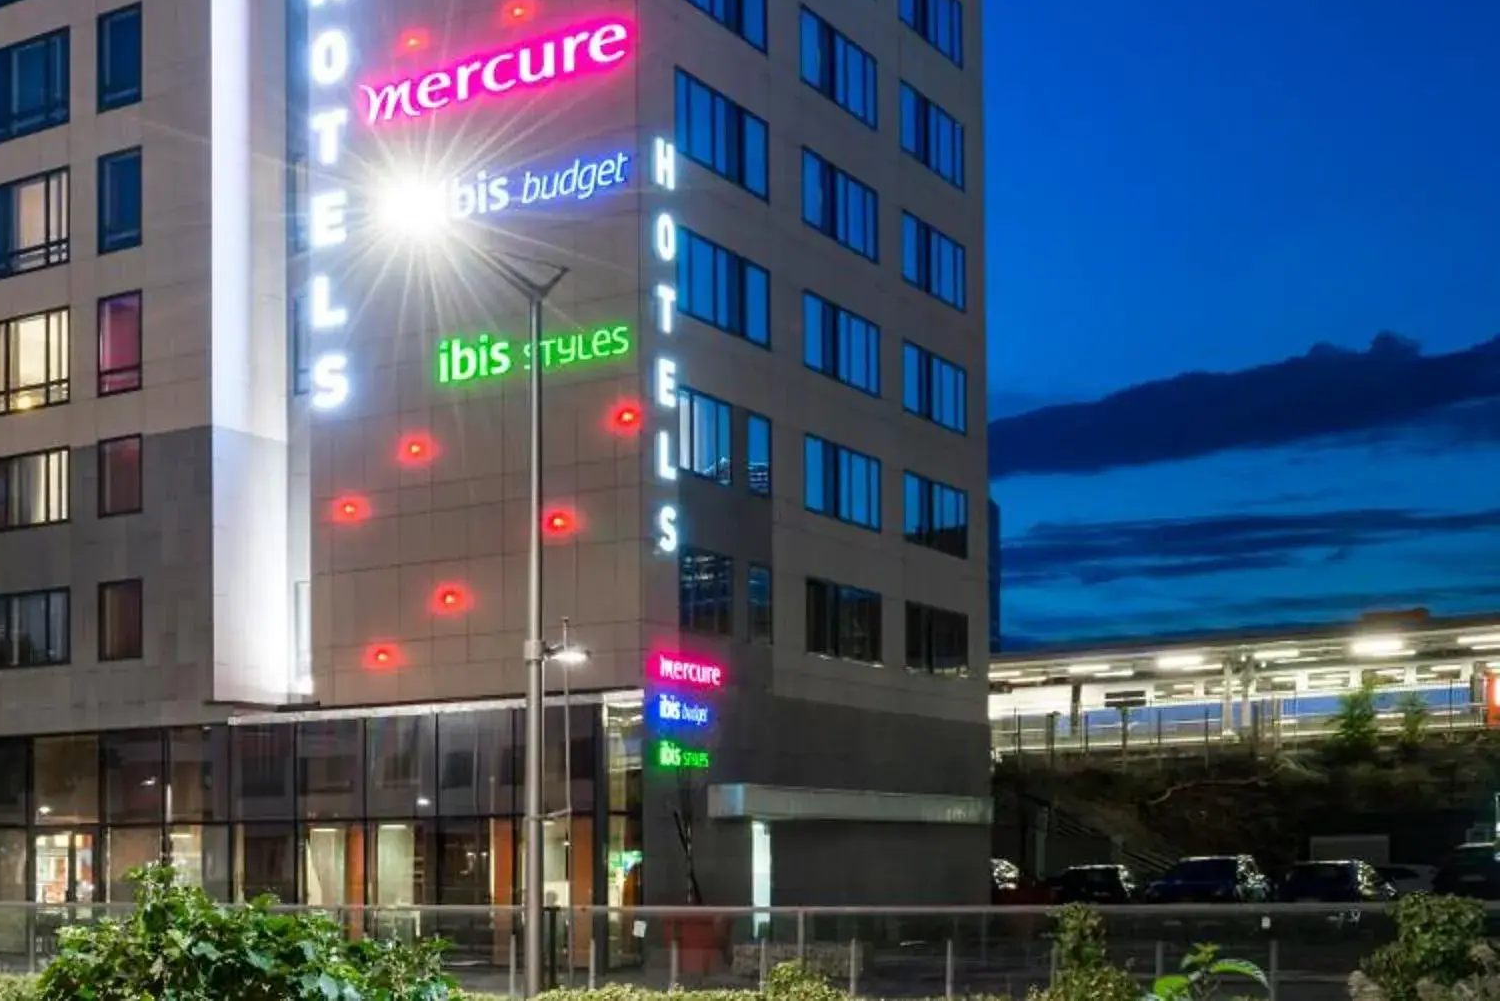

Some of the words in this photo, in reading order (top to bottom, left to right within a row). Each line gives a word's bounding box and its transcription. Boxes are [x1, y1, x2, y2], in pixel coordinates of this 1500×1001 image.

[359, 22, 628, 125] mercure
[437, 169, 510, 219] bis
[521, 152, 628, 204] budget
[439, 334, 511, 383] ibis
[654, 137, 677, 552] HOTELS
[659, 654, 721, 686] mercure
